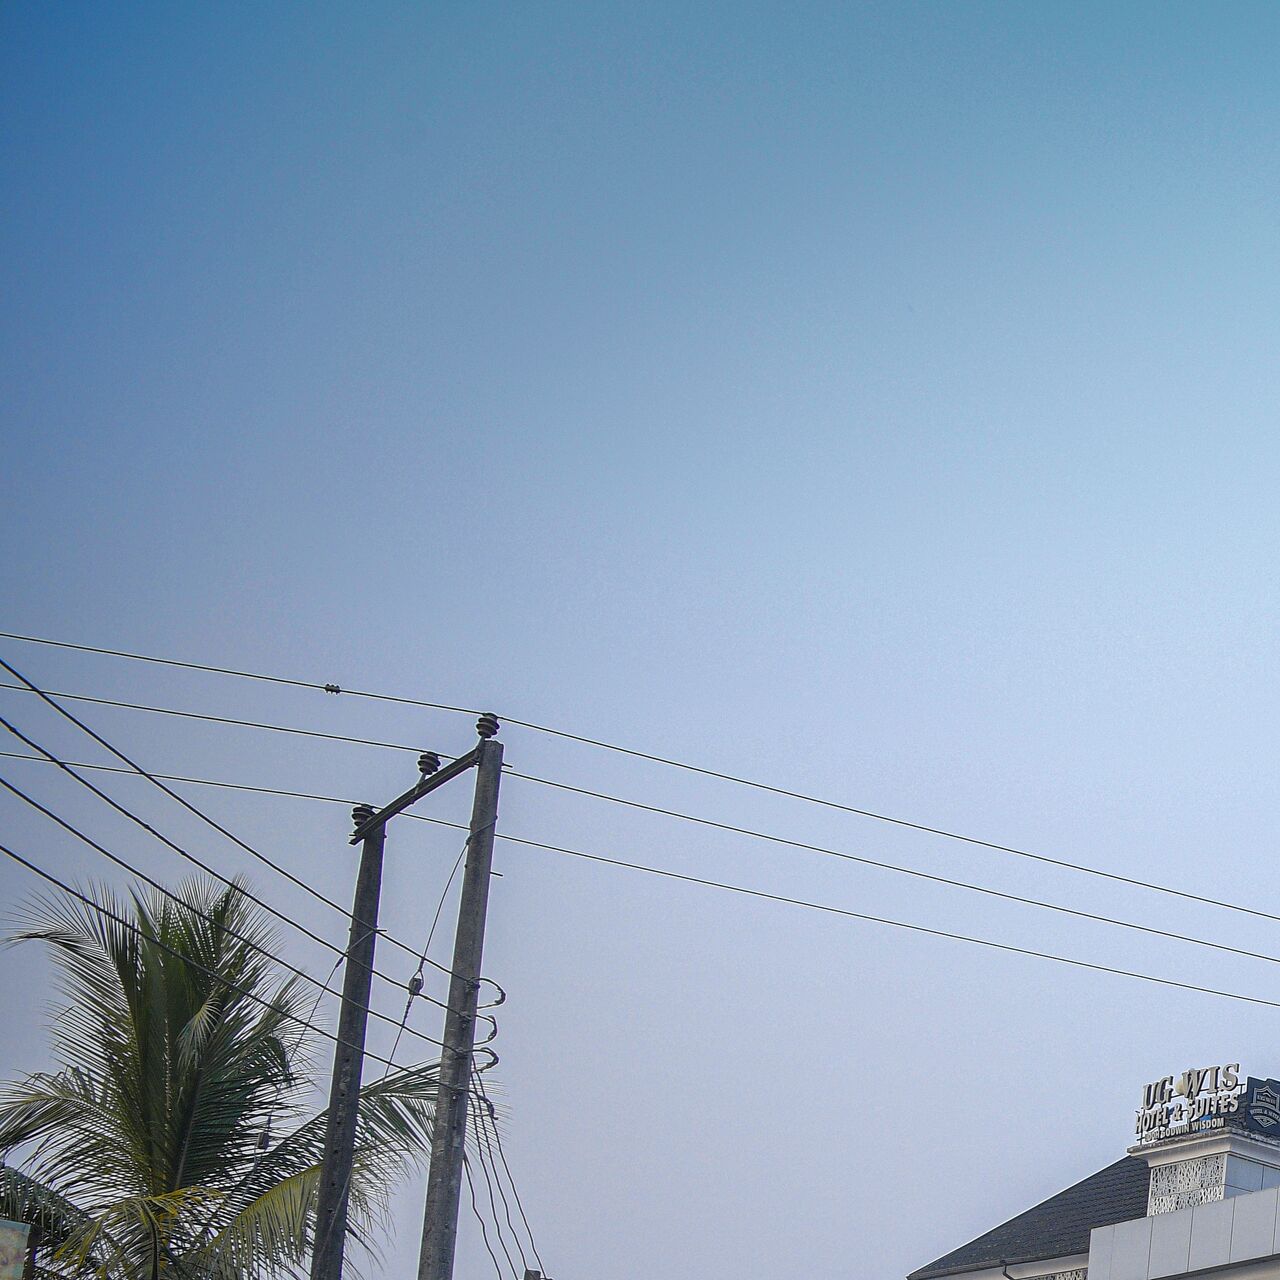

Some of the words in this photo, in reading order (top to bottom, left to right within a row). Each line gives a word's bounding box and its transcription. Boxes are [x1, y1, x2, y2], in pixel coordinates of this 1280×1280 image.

[1142, 1075, 1174, 1111] UG
[1181, 1063, 1240, 1098] WIS
[1135, 1107, 1169, 1134] HOTEL
[1172, 1103, 1183, 1122] &
[1186, 1092, 1240, 1119] SUITES
[1159, 1123, 1190, 1138] GODWIN
[1191, 1117, 1225, 1132] WISDOM
